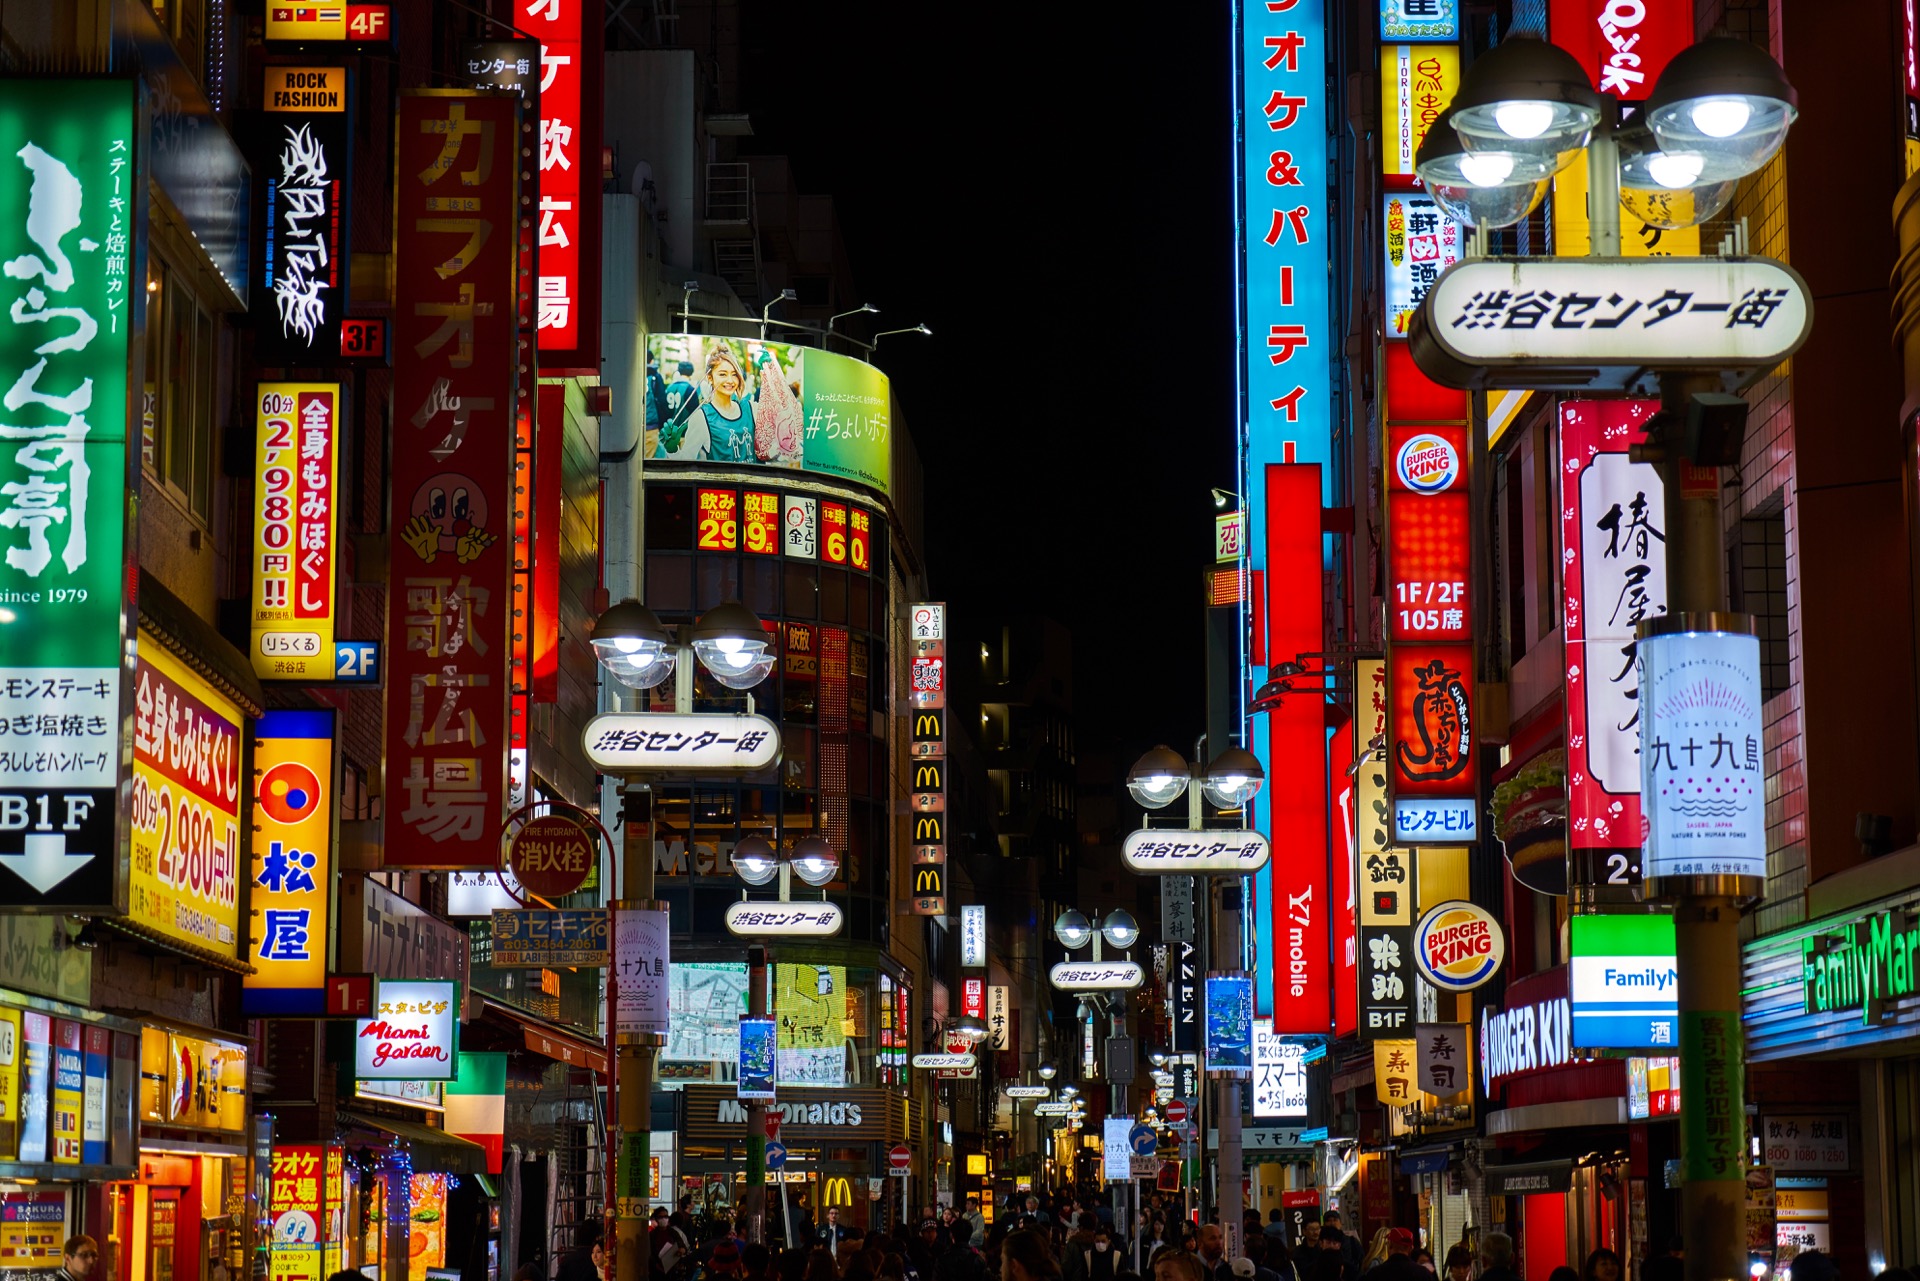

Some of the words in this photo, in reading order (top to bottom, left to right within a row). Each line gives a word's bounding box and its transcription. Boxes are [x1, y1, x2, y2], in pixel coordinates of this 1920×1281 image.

[350, 12, 385, 35] 4F
[467, 58, 530, 75] センター街
[286, 73, 327, 89] ROCK
[274, 91, 338, 107] FASHION
[1401, 57, 1410, 158] TORIKIZOKU
[105, 139, 127, 334] ステーキと焙煎カレー
[1388, 201, 1404, 262] 激安酒場
[1451, 287, 1790, 330] 渋谷センター街
[347, 324, 378, 351] 3F
[261, 393, 295, 415] 60分
[805, 407, 888, 444] #ちょいボラ
[1406, 447, 1448, 468] BURGER
[1408, 455, 1450, 482] KING
[300, 398, 330, 612] 全身もみほぐし
[788, 528, 804, 546] 金
[804, 501, 815, 556] やきとり
[1219, 521, 1244, 555] 恋
[48, 588, 88, 604] 1979
[917, 624, 930, 637] 金
[931, 606, 941, 639] やきとり
[1399, 608, 1463, 630] 105席
[265, 636, 315, 652] りらくる
[274, 660, 307, 674] 渋谷店
[337, 647, 375, 676] 2F
[0, 677, 111, 700] モンステーキ
[135, 670, 239, 803] 全身もみほぐし
[592, 729, 769, 753] 渋谷センター街
[1650, 731, 1760, 773] 九十九島
[0, 793, 96, 832] B1F
[131, 772, 159, 837] 60分
[525, 827, 542, 837] FIRE
[544, 827, 580, 837] HYDRANT
[1396, 809, 1475, 832] センタービル
[1714, 821, 1733, 829] JAPAN
[518, 841, 586, 873] 消火栓
[1132, 841, 1263, 859] 渋谷センター街
[1366, 853, 1406, 884] 鍋
[1673, 863, 1704, 874] 長崎県
[1711, 862, 1751, 873] 佐世保市
[257, 841, 317, 962] 松屋
[522, 911, 608, 938] セキネ
[731, 911, 837, 926] 渋谷センター街
[513, 939, 597, 950] 03-3464-2061
[1428, 920, 1489, 950] BURGER
[496, 952, 518, 963] 買取
[1431, 934, 1492, 971] KING
[615, 956, 665, 978] 十九島
[1056, 969, 1137, 982] 渋谷センター街
[1368, 933, 1405, 1001] 米助
[1802, 913, 1920, 1026] FamilyMar
[335, 982, 365, 1011] 1F
[378, 1001, 449, 1015] スタとピザ
[359, 1020, 431, 1040] Miami
[991, 1014, 1006, 1050] 牛タン
[1368, 1012, 1406, 1028] B1F
[1650, 1021, 1671, 1044] 酒
[372, 1042, 449, 1067] garden
[1489, 1006, 1537, 1078] BURGER
[916, 1057, 969, 1066] 渋谷センター街
[1428, 1034, 1456, 1089] 寿司
[1385, 1050, 1410, 1100] 寿司
[717, 1099, 862, 1126] Monald's
[272, 1151, 320, 1176] ラオケ
[1767, 1148, 1790, 1161] 800
[273, 1177, 318, 1202] 広場
[17, 1204, 62, 1213] SAKURA
[291, 1203, 319, 1212] ROOM
